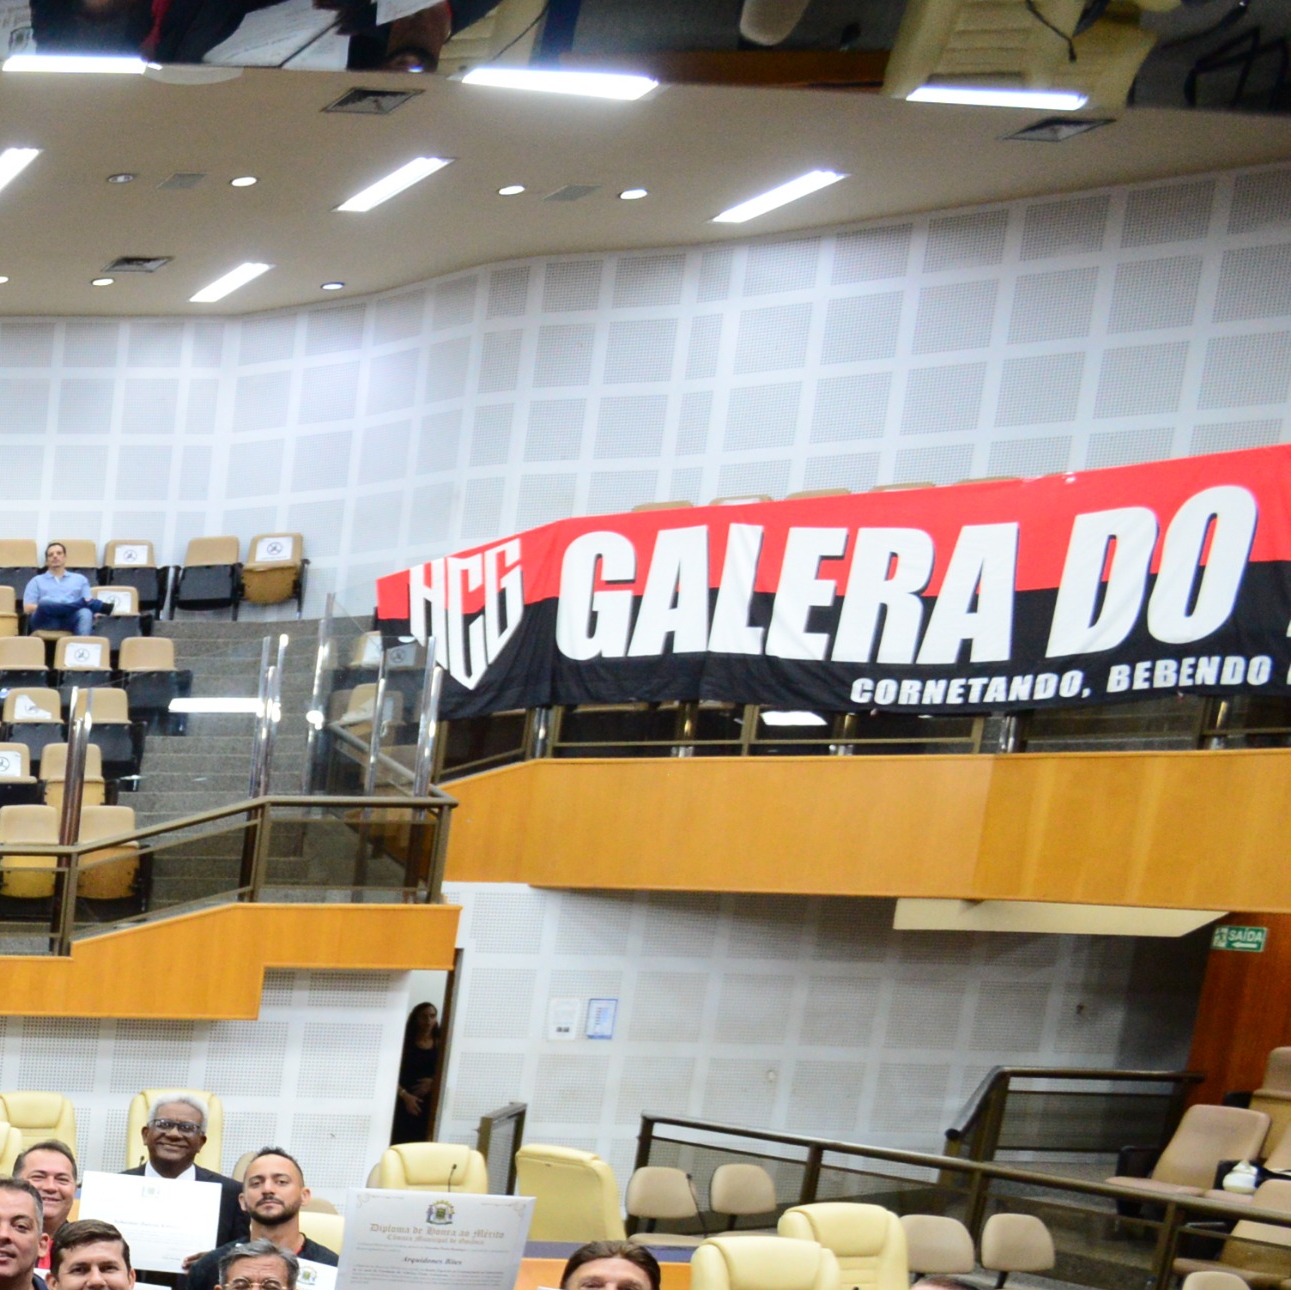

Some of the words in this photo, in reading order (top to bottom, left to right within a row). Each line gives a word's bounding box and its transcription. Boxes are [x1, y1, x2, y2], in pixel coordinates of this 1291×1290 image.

[557, 524, 1019, 666] GALERA
[1046, 485, 1258, 658] DO
[851, 672, 1092, 705] CORNETANDO,
[1106, 657, 1270, 693] BEBENDO
